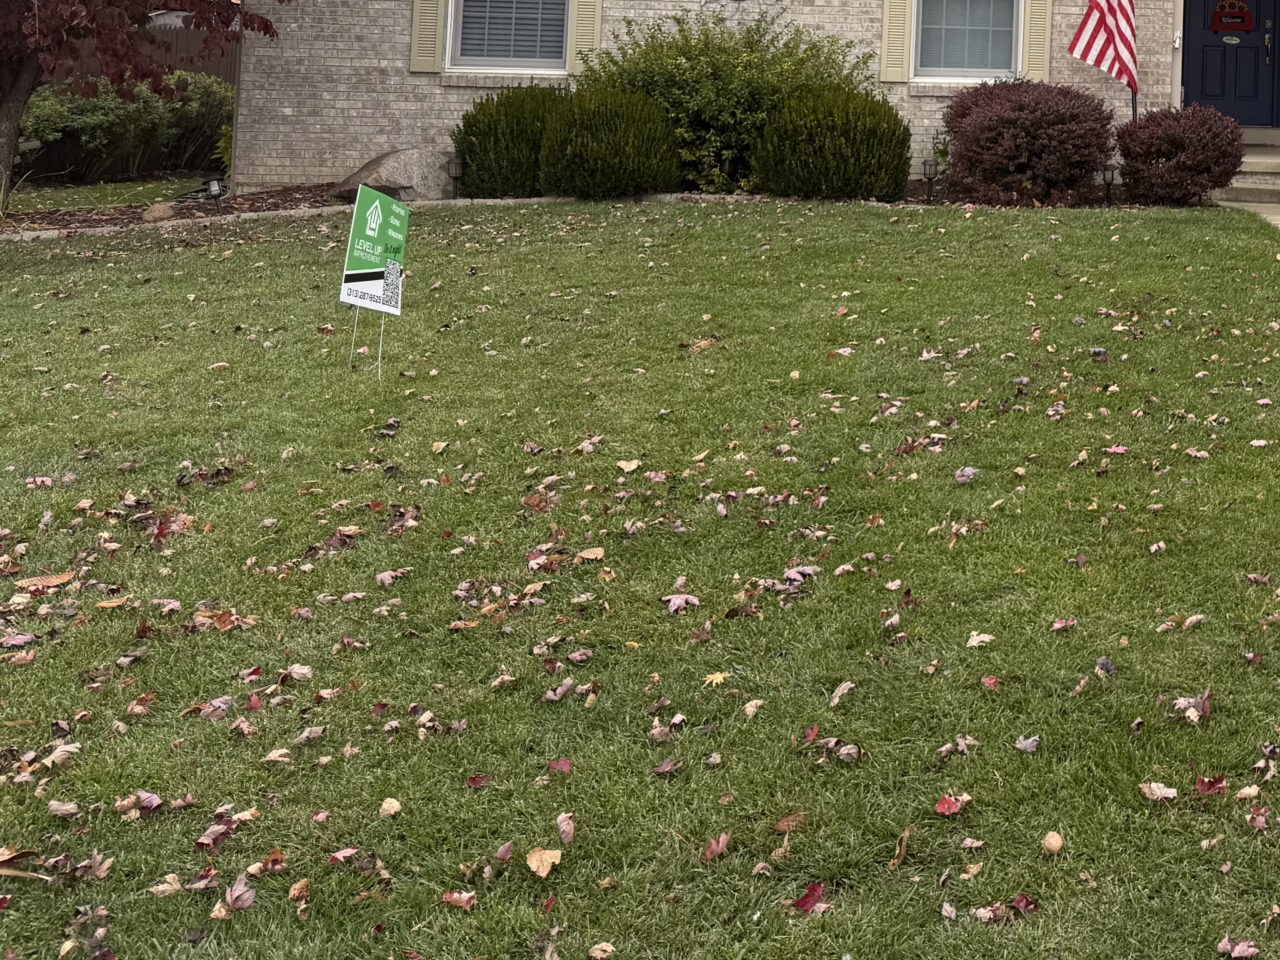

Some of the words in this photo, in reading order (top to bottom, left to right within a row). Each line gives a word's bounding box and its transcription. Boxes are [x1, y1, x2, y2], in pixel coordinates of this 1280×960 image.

[355, 238, 373, 253] LEVEL
[374, 244, 382, 255] UP
[353, 249, 380, 263] IMPROVEMENT
